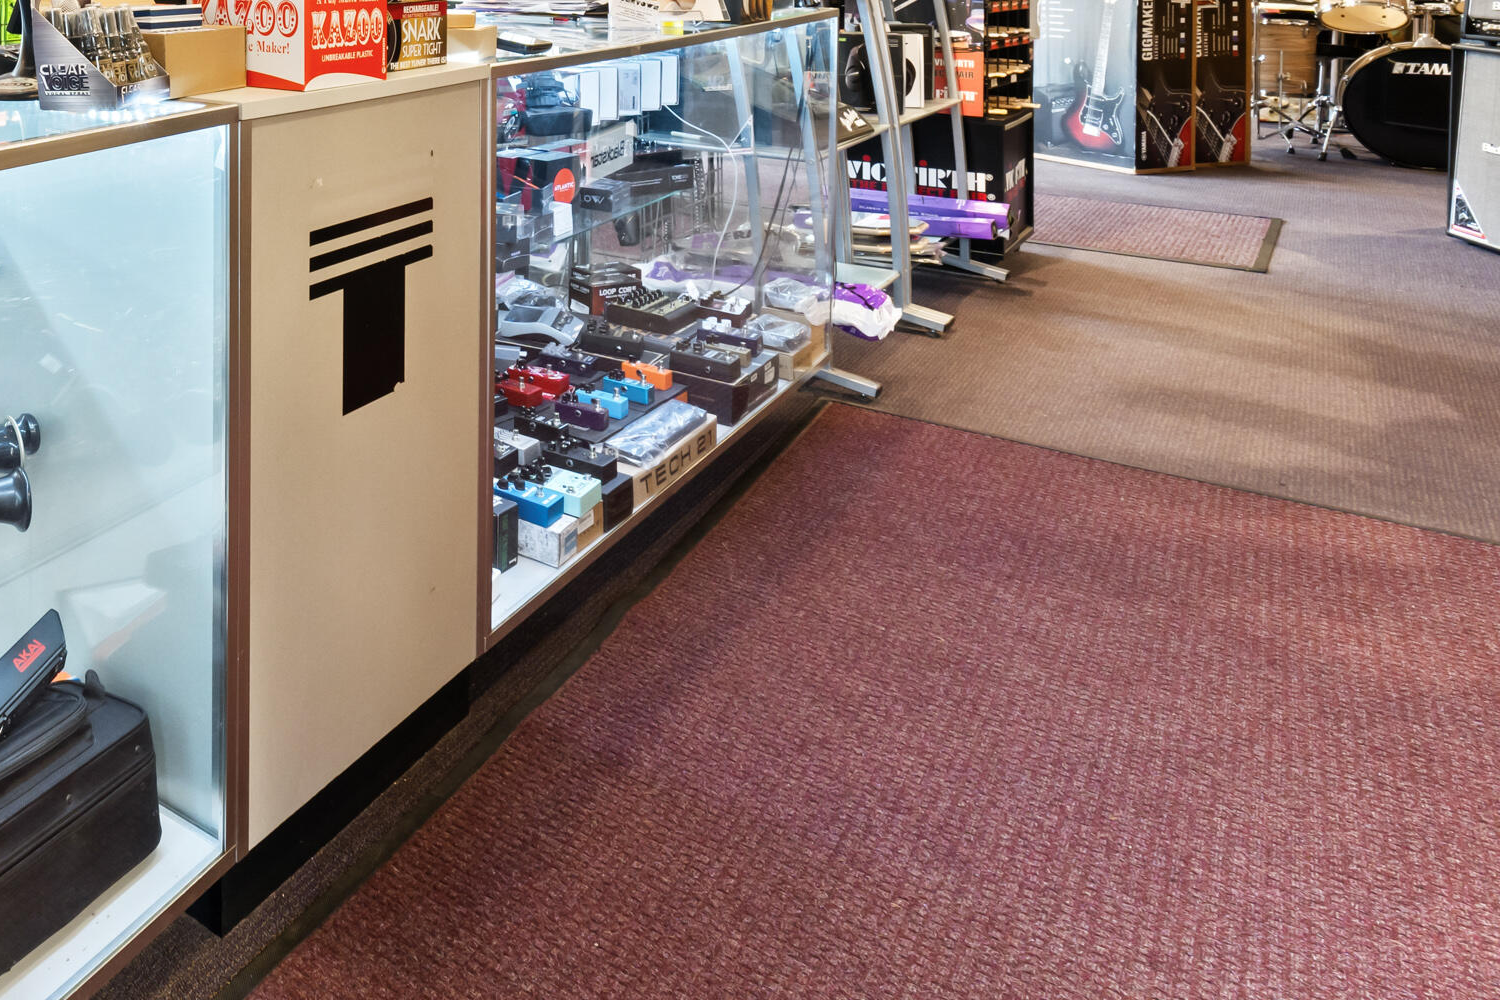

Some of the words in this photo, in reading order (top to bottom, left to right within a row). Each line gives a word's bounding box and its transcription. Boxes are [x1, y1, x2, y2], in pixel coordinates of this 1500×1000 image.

[403, 4, 439, 14] RECHARGEABLE!
[311, 7, 384, 50] KAZOO
[402, 17, 441, 43] SNARK
[256, 40, 290, 55] Maker!
[402, 43, 422, 58] SUPER
[423, 42, 443, 57] TIGHT
[321, 52, 356, 62] UNBREAKABLE
[356, 50, 374, 61] PLASTIC
[39, 63, 88, 76] CLEAR
[1405, 63, 1452, 76] TAM
[39, 73, 91, 92] VOICE
[598, 287, 617, 297] LOOP
[639, 450, 693, 495] TECH
[696, 429, 715, 455] 21
[12, 638, 46, 672] AKAI
